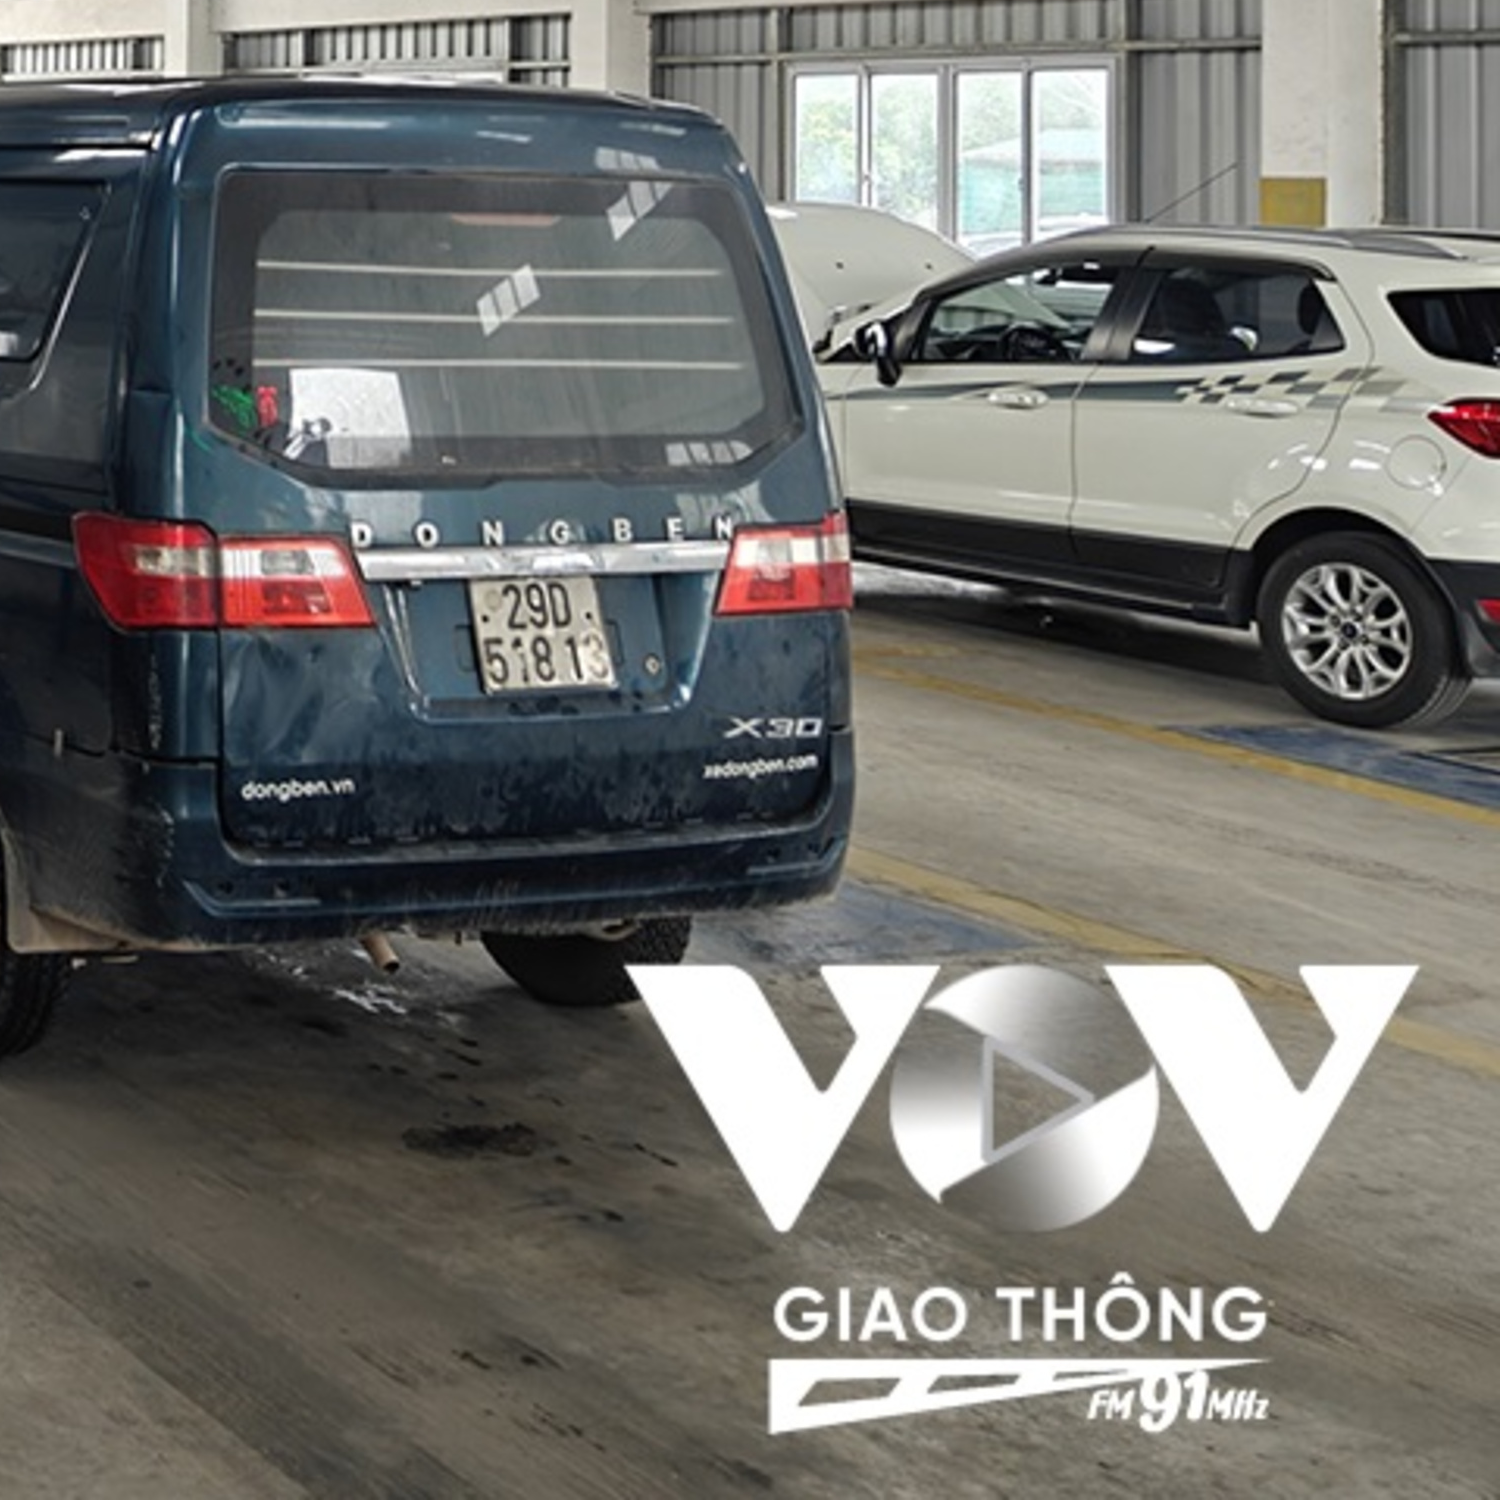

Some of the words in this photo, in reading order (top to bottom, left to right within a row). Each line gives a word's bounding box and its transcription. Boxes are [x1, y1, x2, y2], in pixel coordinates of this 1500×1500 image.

[502, 582, 572, 630] 29D
[723, 717, 823, 739] X30
[241, 779, 356, 803] dongben.vn
